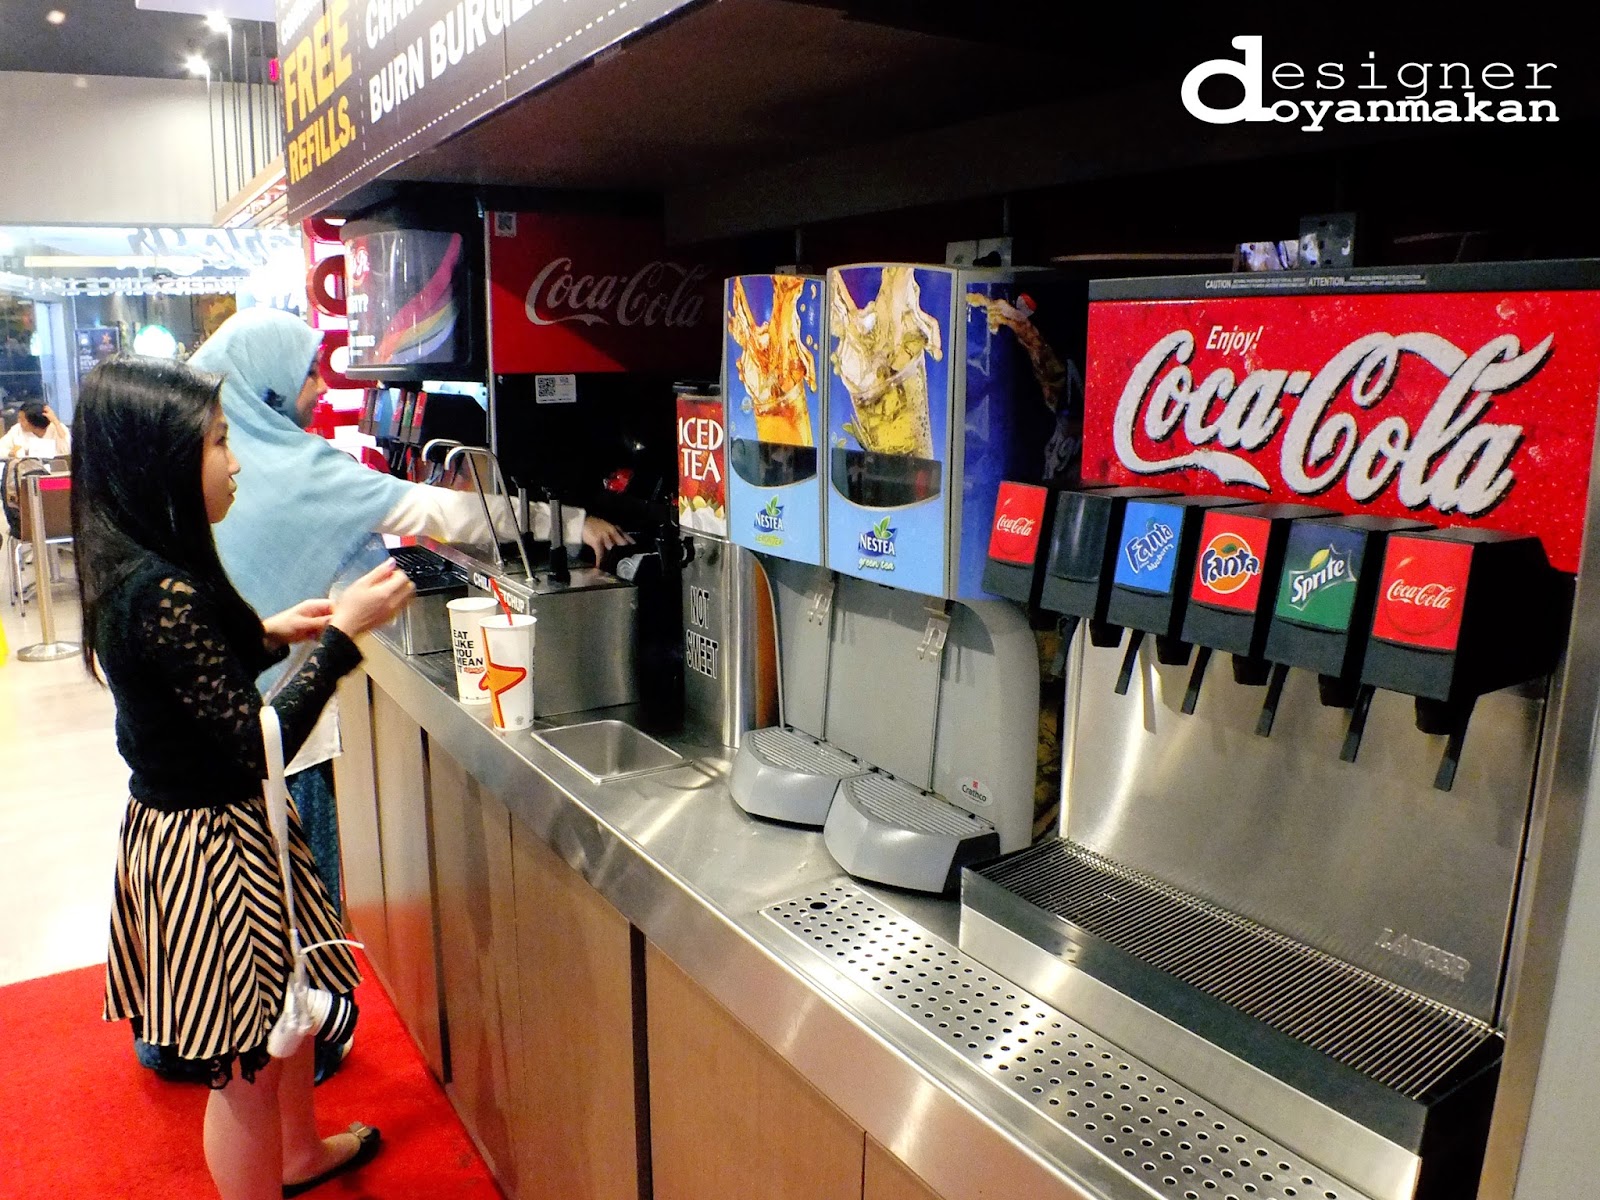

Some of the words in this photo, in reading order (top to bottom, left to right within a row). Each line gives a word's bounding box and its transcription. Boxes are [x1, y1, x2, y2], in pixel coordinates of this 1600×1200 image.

[283, 0, 353, 133] FREE
[369, 36, 425, 124] BURN
[288, 95, 356, 185] REFILLS.
[525, 256, 711, 328] Coca-Cola
[1205, 279, 1232, 289] CAUTION
[1206, 325, 1263, 355] Enjoy!
[678, 416, 724, 451] ICED
[1113, 329, 1554, 515] Coca-Cola
[681, 448, 721, 483] TEA
[755, 512, 784, 531] NESTEA
[997, 514, 1036, 537] Coca-Cola
[860, 533, 896, 556] NESTEA
[1125, 523, 1174, 574] Fanta
[1200, 549, 1260, 587] Fanta
[1290, 557, 1347, 604] Sprite
[691, 585, 710, 629] NOT
[1386, 579, 1456, 610] Coca-Cola
[453, 629, 468, 640] EAT
[455, 638, 475, 649] LIKE
[456, 648, 473, 658] YOU
[456, 657, 484, 667] MEAN
[686, 629, 719, 679] SWEET
